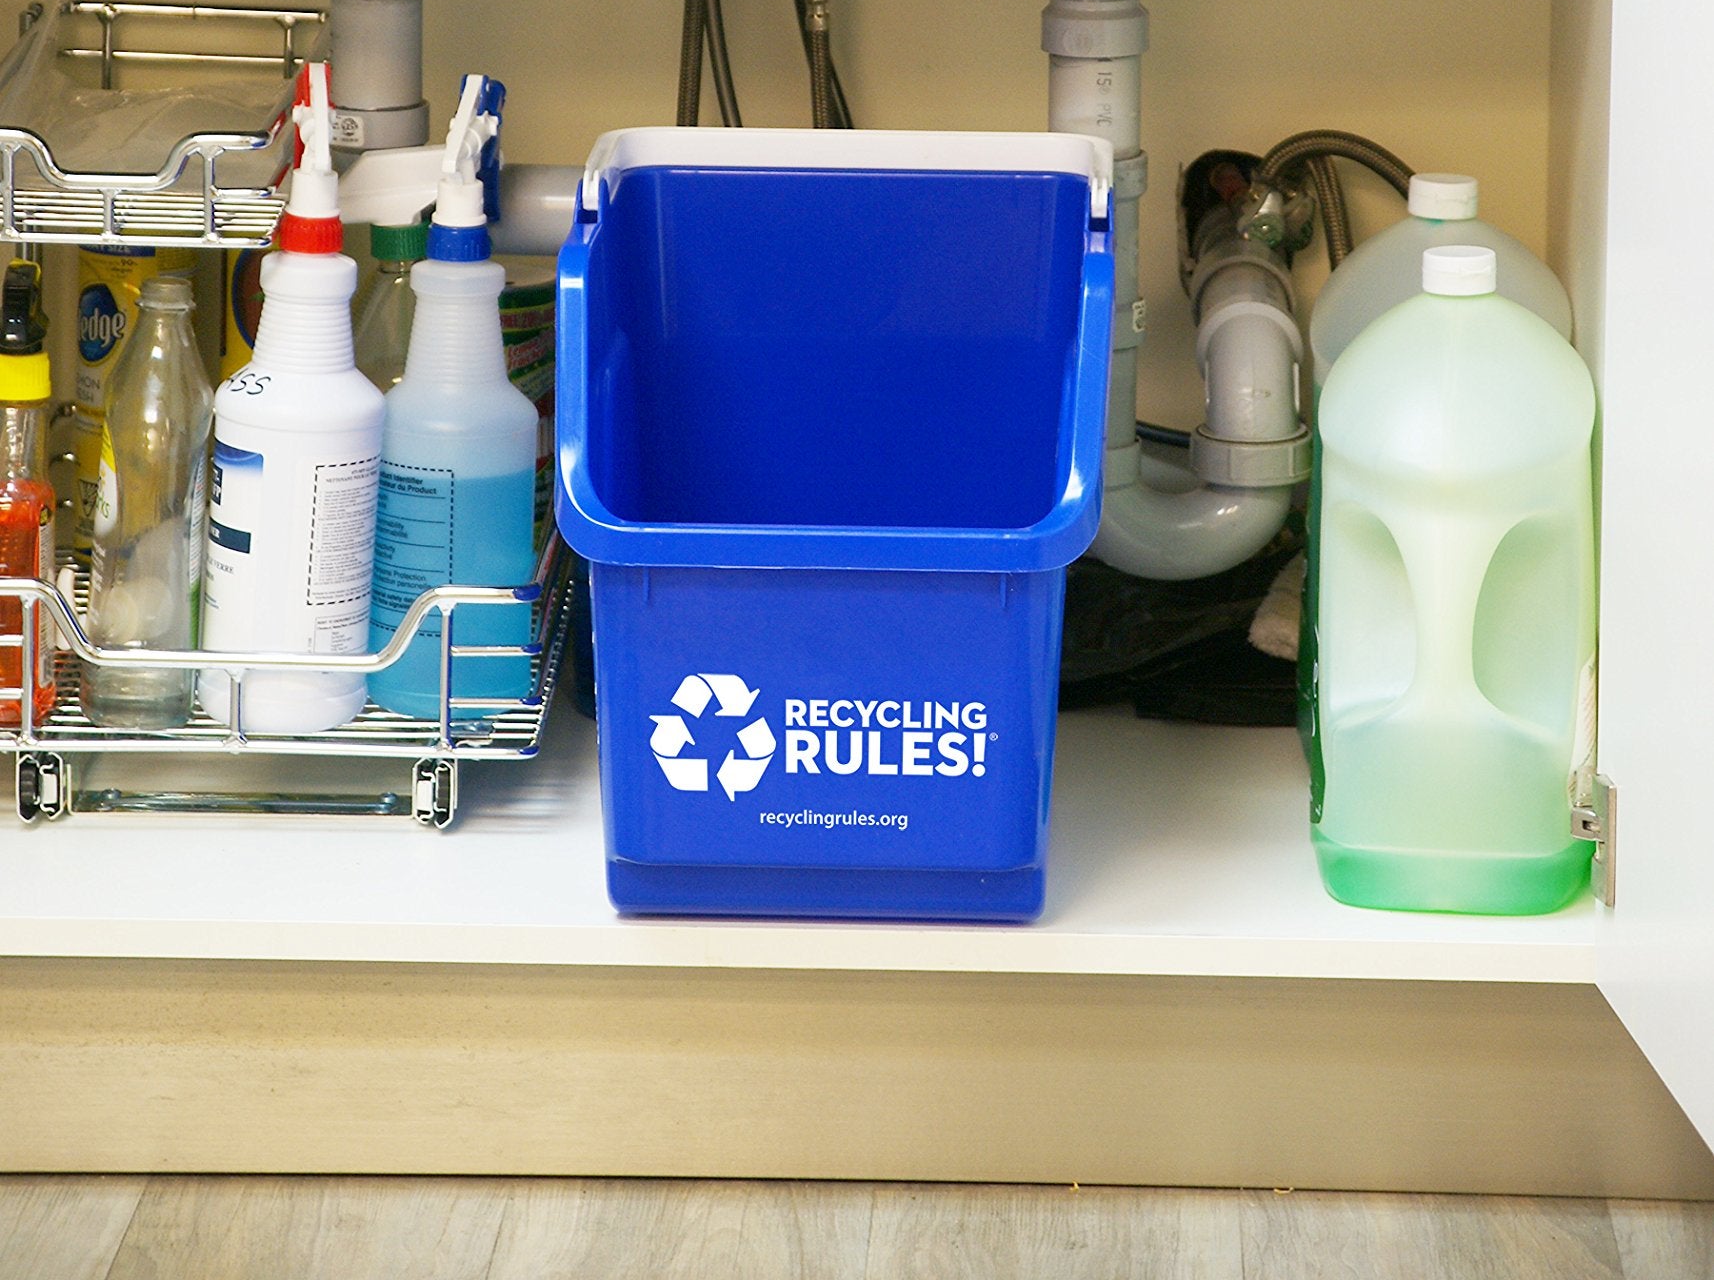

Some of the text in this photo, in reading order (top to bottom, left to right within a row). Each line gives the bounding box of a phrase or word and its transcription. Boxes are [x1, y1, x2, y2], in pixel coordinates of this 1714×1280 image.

[79, 307, 126, 348] edge
[407, 484, 437, 495] Product
[785, 699, 988, 730] RECYCLING
[760, 809, 908, 830] recyclingrules.org
